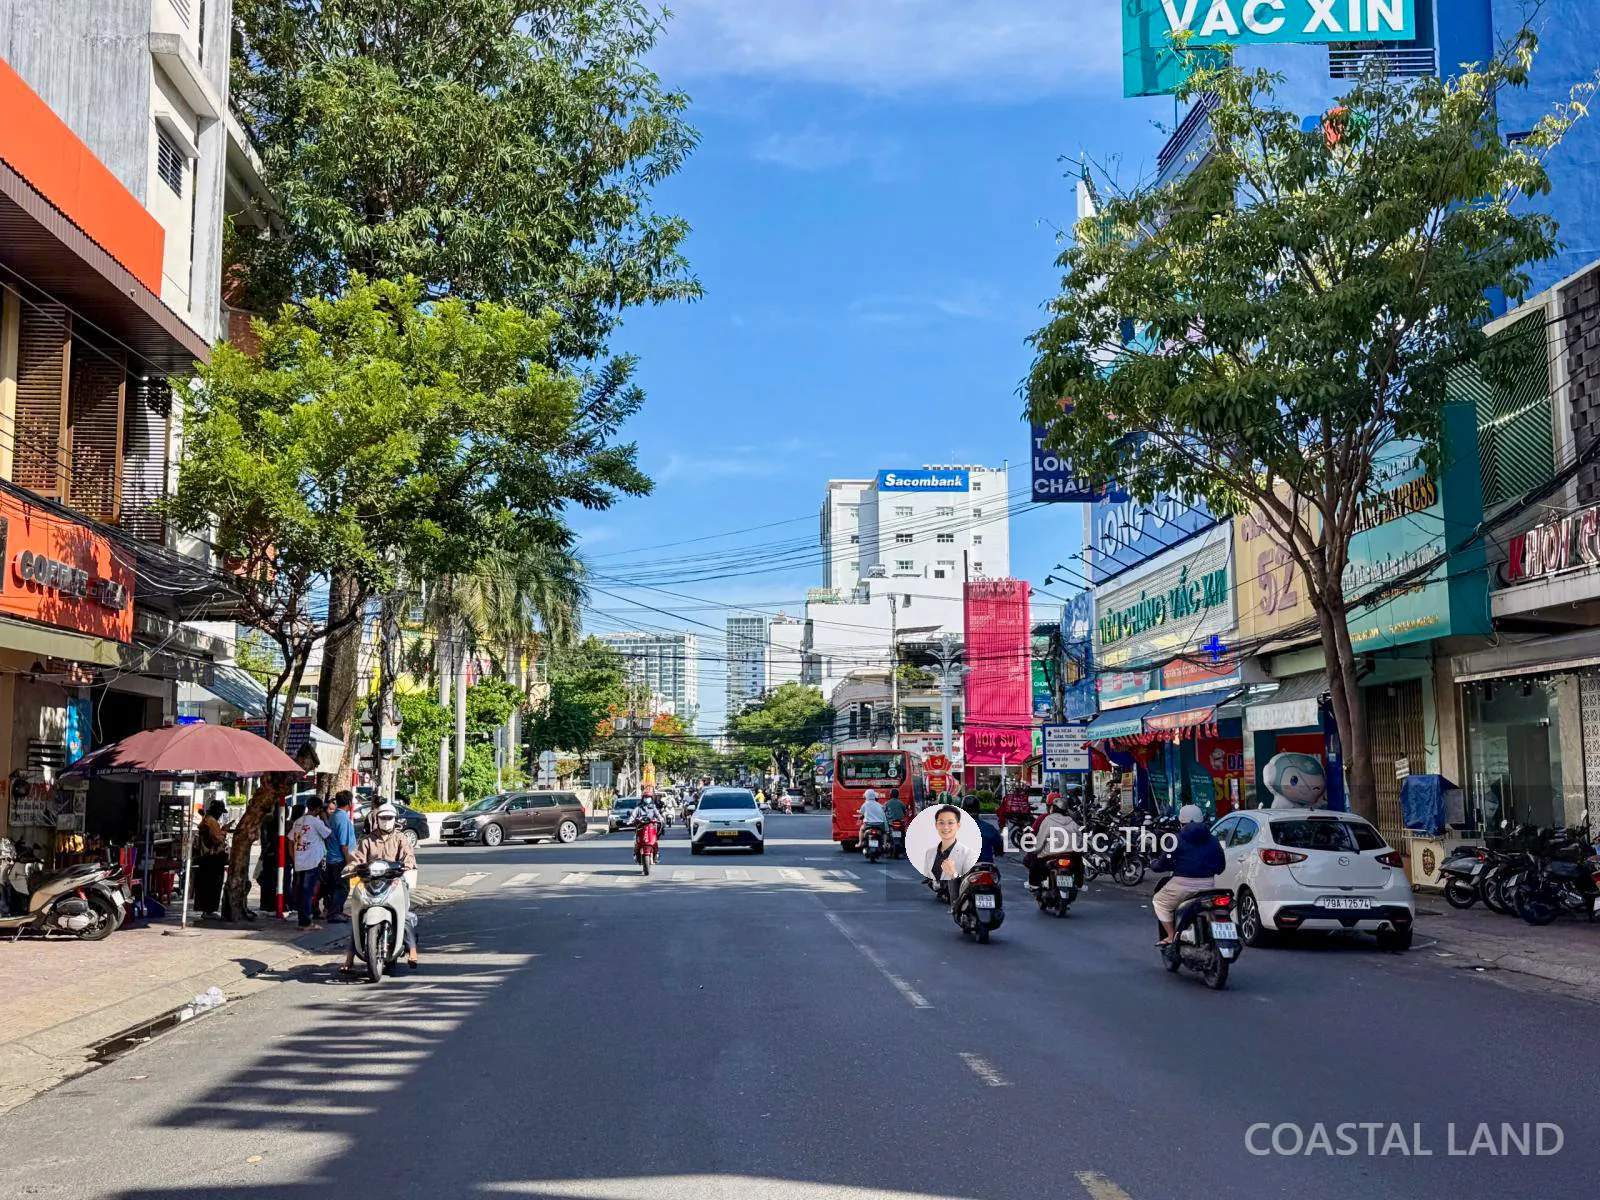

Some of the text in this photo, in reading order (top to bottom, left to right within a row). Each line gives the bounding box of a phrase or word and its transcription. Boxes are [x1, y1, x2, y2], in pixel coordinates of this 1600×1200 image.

[1302, 0, 1404, 33] XIN
[885, 473, 963, 488] Sacombank
[1034, 456, 1086, 472] LON
[1507, 509, 1571, 579] KHÔI
[18, 550, 89, 598] COFFEE
[1201, 566, 1228, 609] XIN
[1257, 543, 1298, 616] 52
